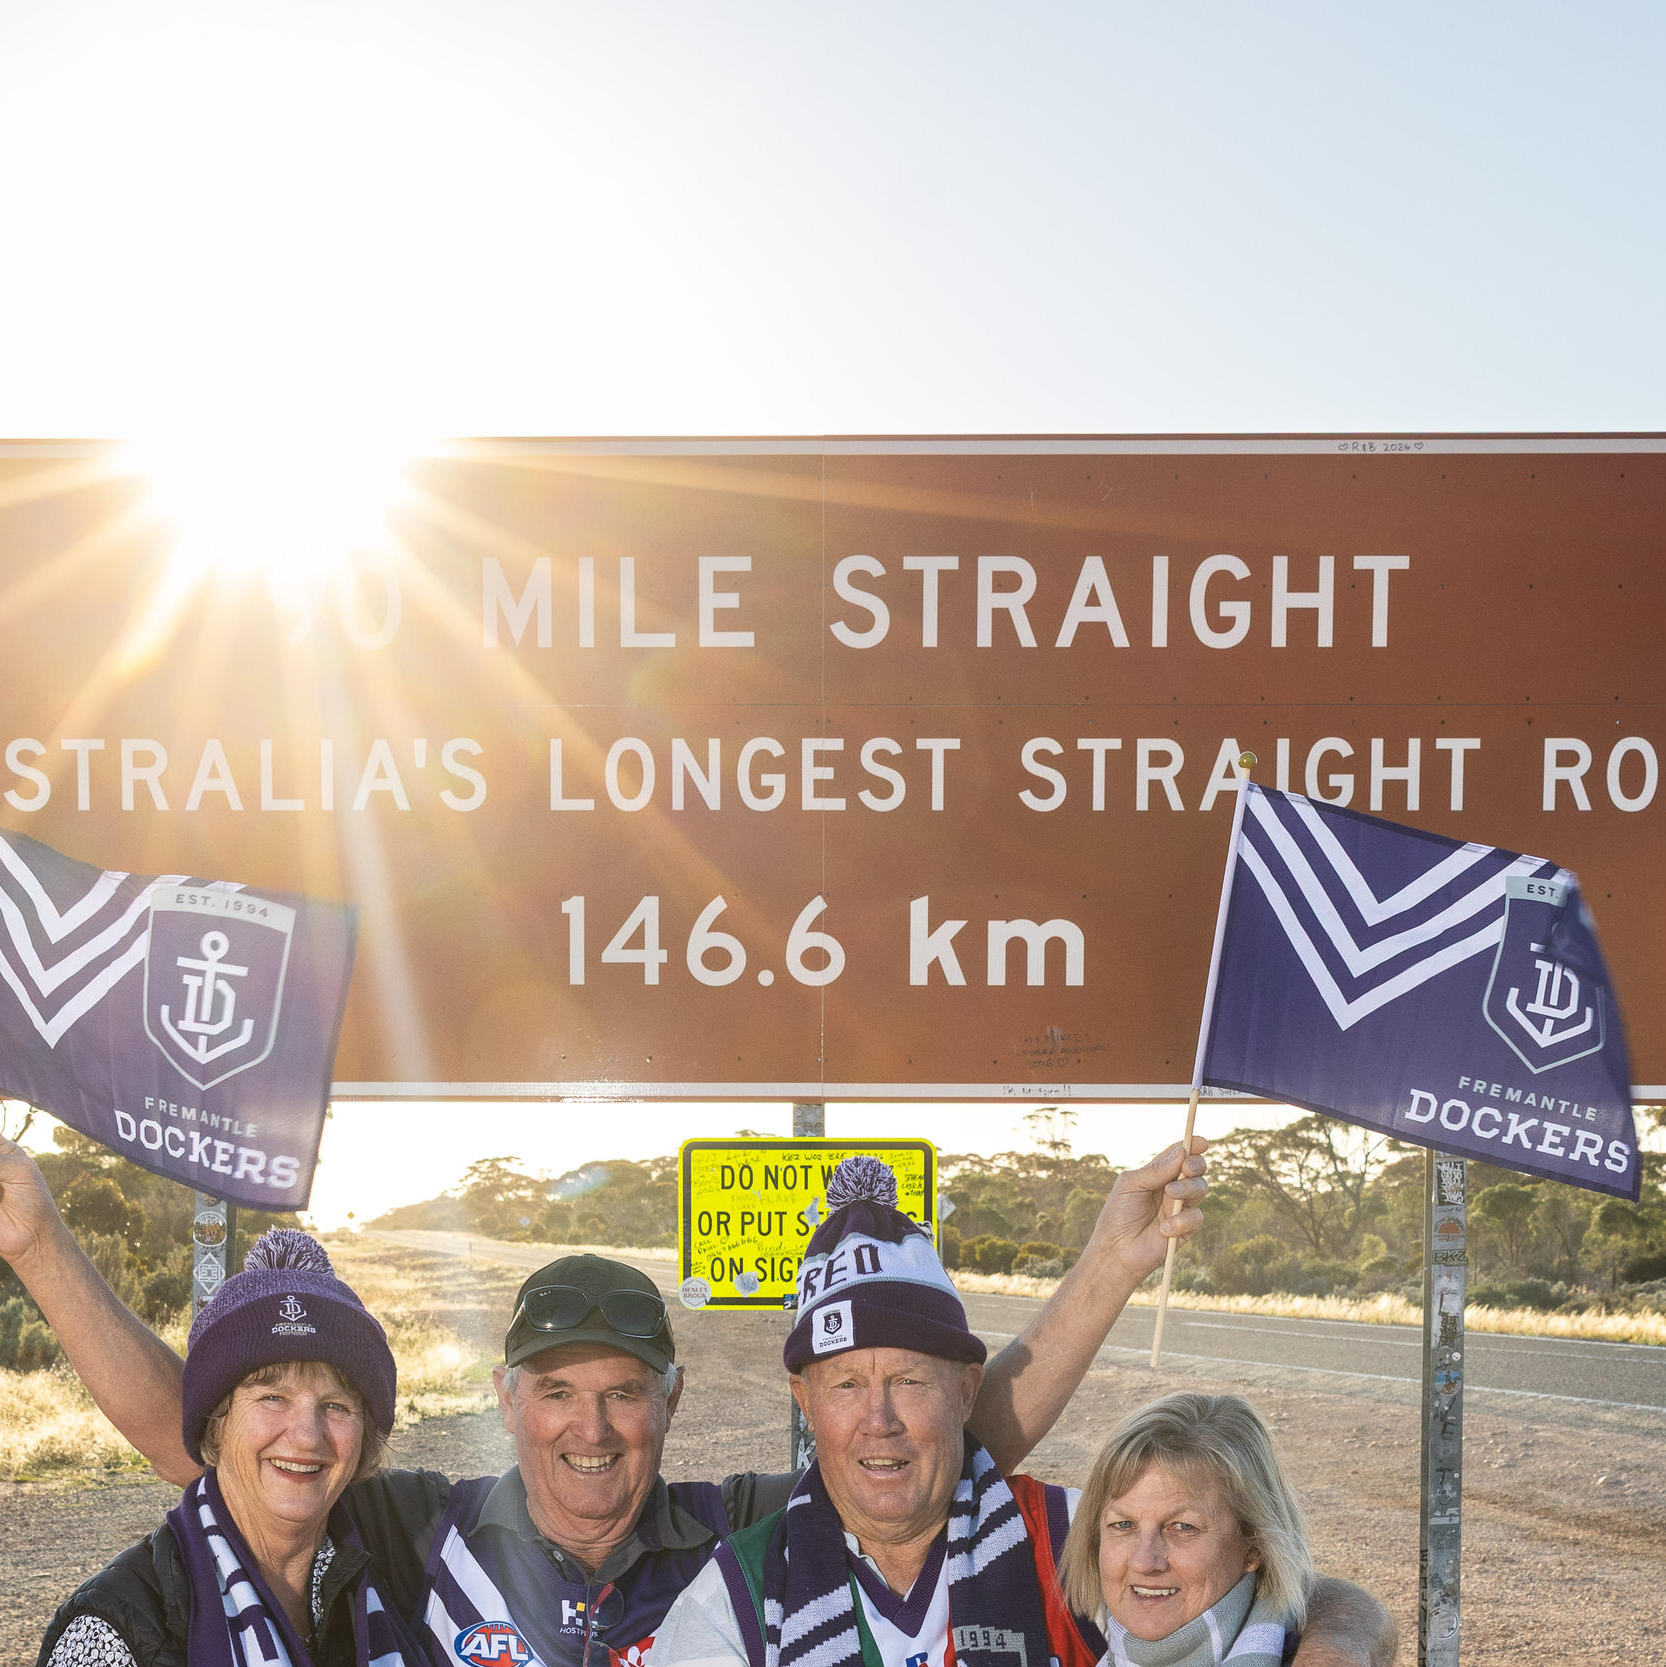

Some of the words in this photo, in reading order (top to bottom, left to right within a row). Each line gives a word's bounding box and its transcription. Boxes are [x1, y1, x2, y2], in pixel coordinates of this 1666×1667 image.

[482, 556, 755, 649] MILE
[829, 554, 1410, 650] STRAIGHT
[548, 736, 961, 812] LONGEST
[1018, 736, 1481, 812] STRAIGHT
[1526, 883, 1559, 899] EST.
[175, 892, 216, 908] EST.
[224, 898, 270, 919] 1994
[561, 894, 847, 987] 146.6
[909, 895, 1085, 987] km
[1457, 1075, 1598, 1122] FREMANTLE
[144, 1096, 259, 1139] FREMANTLE
[1404, 1088, 1631, 1174] DOCKERS
[113, 1109, 301, 1189] DOCKERS
[720, 1164, 754, 1190] DO
[764, 1164, 813, 1190] NOT
[697, 1210, 731, 1236] OR
[740, 1210, 788, 1236] PUT
[710, 1257, 744, 1283] ON
[754, 1257, 805, 1283] SIG
[271, 1324, 317, 1334] DOCKERS
[819, 1336, 848, 1348] DOCKERS
[459, 1632, 529, 1661] AFL
[959, 1629, 1008, 1649] 1994
